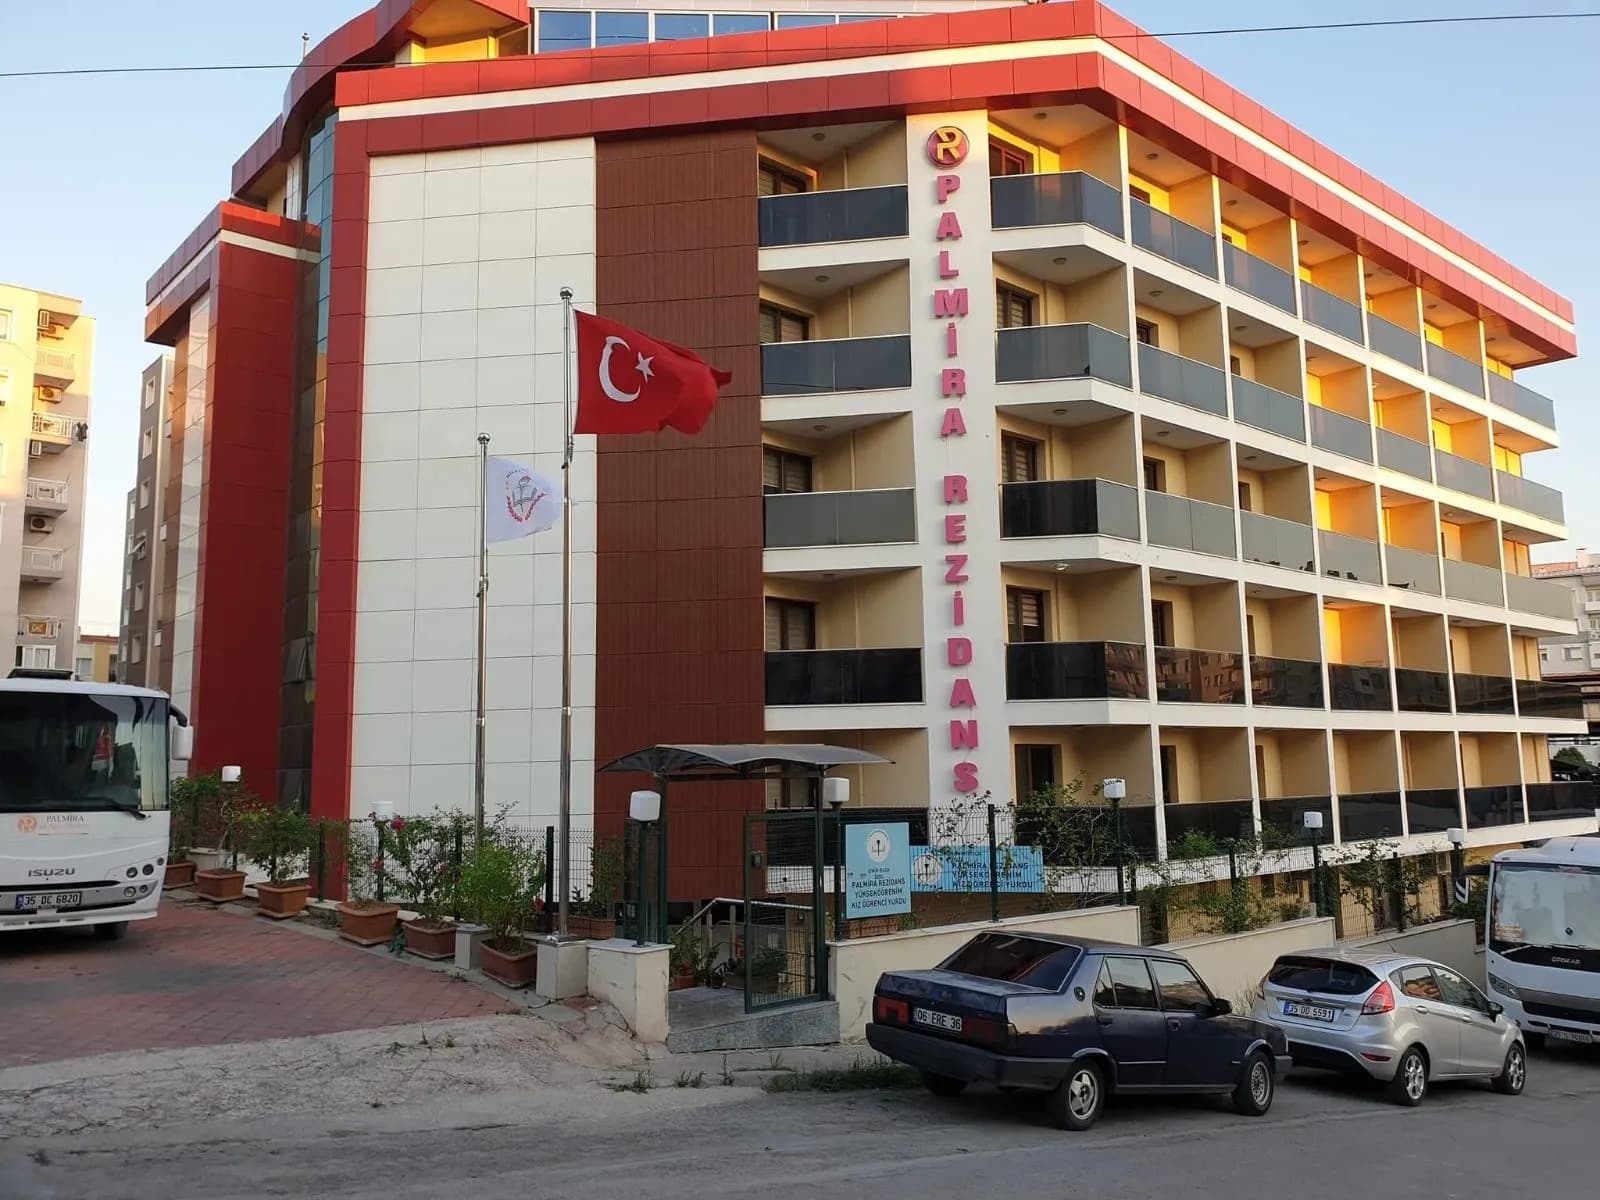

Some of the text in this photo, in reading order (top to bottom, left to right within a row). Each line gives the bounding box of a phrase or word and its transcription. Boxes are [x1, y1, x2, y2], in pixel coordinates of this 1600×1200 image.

[934, 175, 968, 438] PALMİRA
[944, 475, 978, 793] REZİDANS
[28, 867, 76, 877] ISUZU
[24, 896, 36, 905] 35
[41, 895, 53, 904] DC
[851, 901, 861, 909] KIZ
[888, 897, 907, 906] YURDU
[1313, 1007, 1332, 1018] 5591
[917, 1010, 961, 1029] 06 ERE 36
